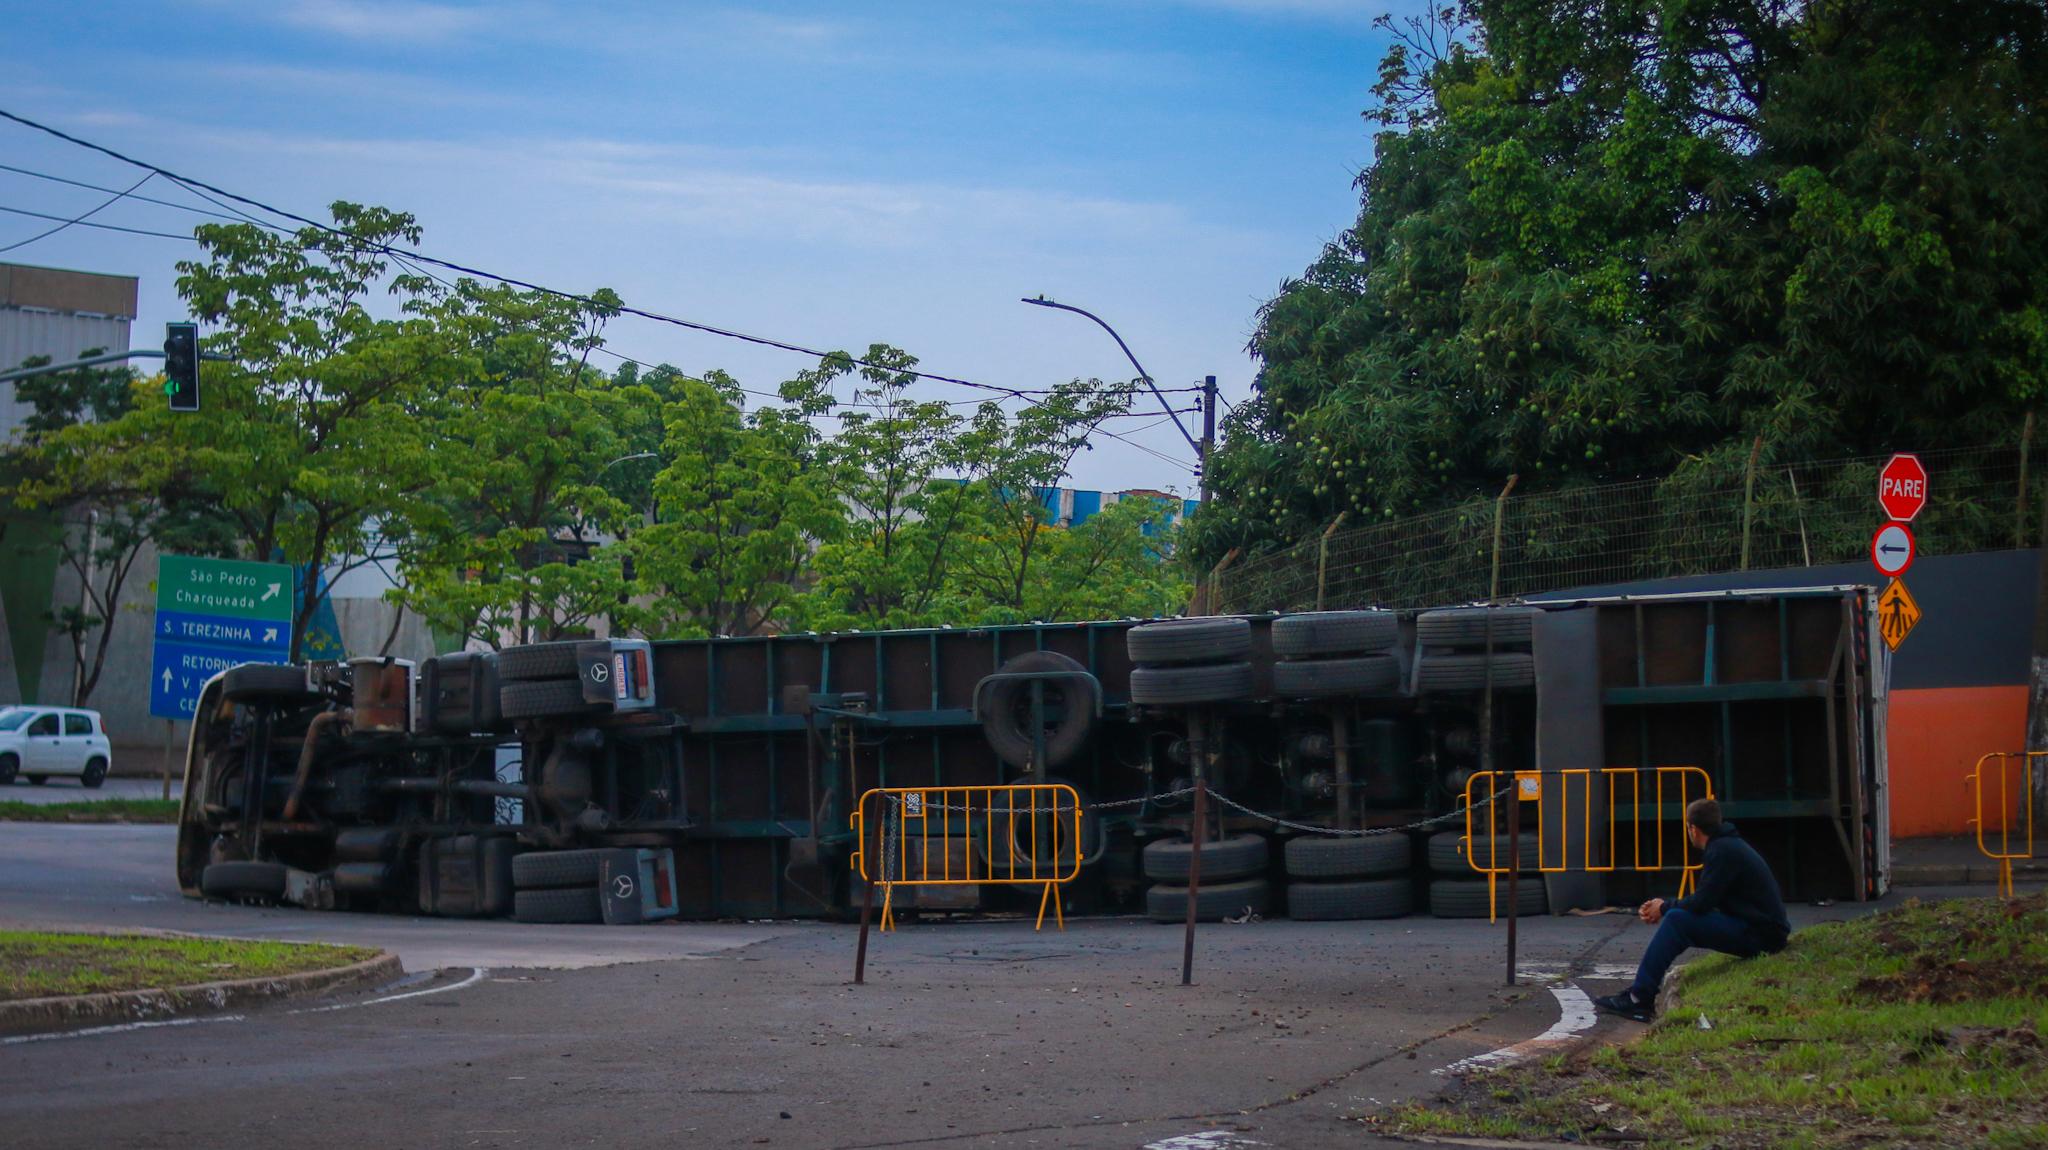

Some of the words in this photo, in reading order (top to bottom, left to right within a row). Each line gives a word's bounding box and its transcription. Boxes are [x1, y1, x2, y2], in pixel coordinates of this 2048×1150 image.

[1883, 478, 1922, 498] PARE
[220, 571, 257, 587] Pedro
[176, 590, 255, 609] Charqueada
[164, 621, 174, 633] S.
[182, 622, 252, 640] TEREZINHA
